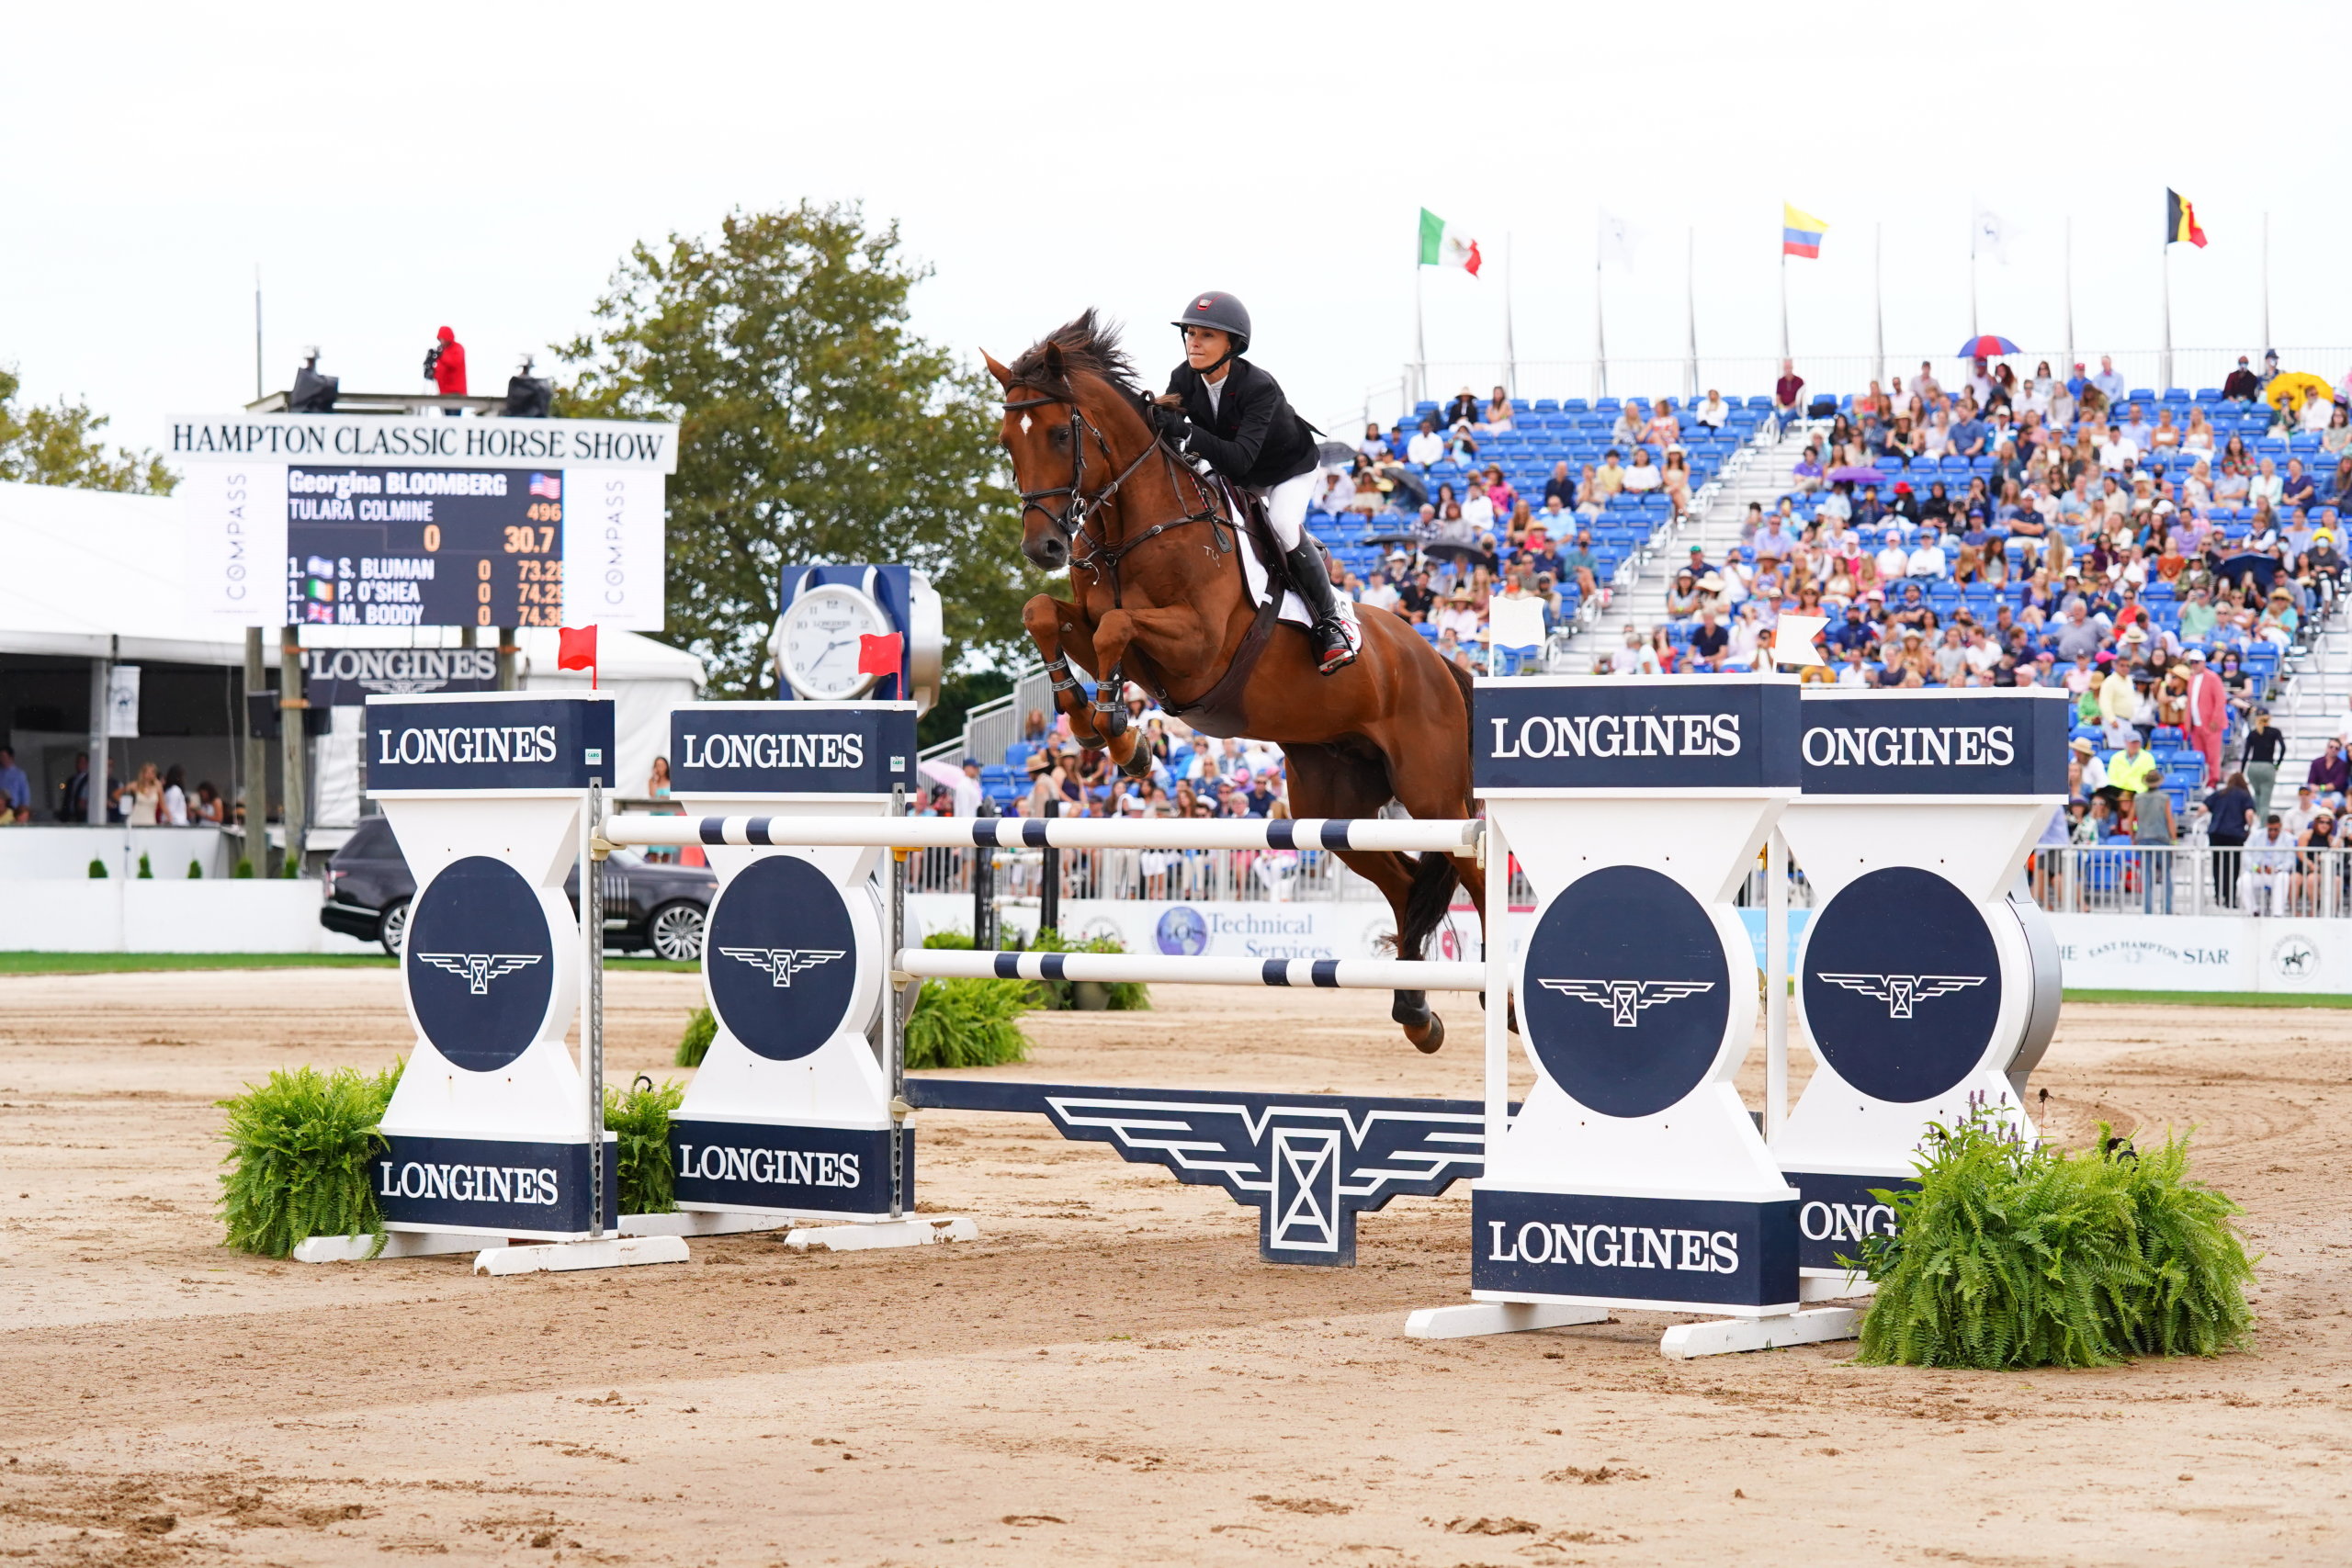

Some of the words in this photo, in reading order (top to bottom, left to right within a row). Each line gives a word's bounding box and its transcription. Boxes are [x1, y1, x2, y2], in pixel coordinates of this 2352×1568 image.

[173, 423, 324, 453] HAMPTON
[334, 426, 458, 456] CLASSIC
[466, 428, 566, 458] HORSE
[573, 432, 663, 461] SHOW
[288, 469, 381, 500] Georgina
[386, 472, 507, 496] BLOOMBERG
[289, 498, 354, 521] TULARA
[359, 500, 434, 522] COLMINE
[526, 502, 562, 522] 496
[227, 473, 246, 600] COMPASS
[424, 525, 441, 551] 0
[503, 525, 555, 553] 30.7
[605, 480, 625, 604] COMPASS
[288, 557, 305, 579] 1.
[338, 557, 356, 580] S.
[360, 558, 435, 581] BLUMAN
[478, 558, 492, 581] 0
[288, 580, 305, 602] 1.
[338, 581, 354, 603] P.
[356, 579, 421, 603] O'SHEA
[478, 581, 492, 604] 0
[288, 603, 305, 625] 1.
[338, 603, 361, 625] M.
[365, 603, 424, 626] BODDY
[478, 604, 492, 626] 0
[310, 649, 497, 681] LONGINES
[379, 725, 558, 765] LONGINES
[1490, 714, 1741, 759] LONGINES
[1802, 726, 2016, 767] ONGINES
[683, 733, 864, 769] LONGINES
[1206, 912, 1313, 935] Technical
[1245, 939, 1332, 959] Services
[2056, 945, 2078, 961] HE
[2088, 942, 2117, 958] EAST
[2120, 941, 2179, 960] HAMPTON
[2183, 947, 2230, 964] STAR
[680, 1145, 861, 1189] LONGINES
[379, 1161, 559, 1205] LONGINES
[1488, 1220, 1739, 1275] LONGINES
